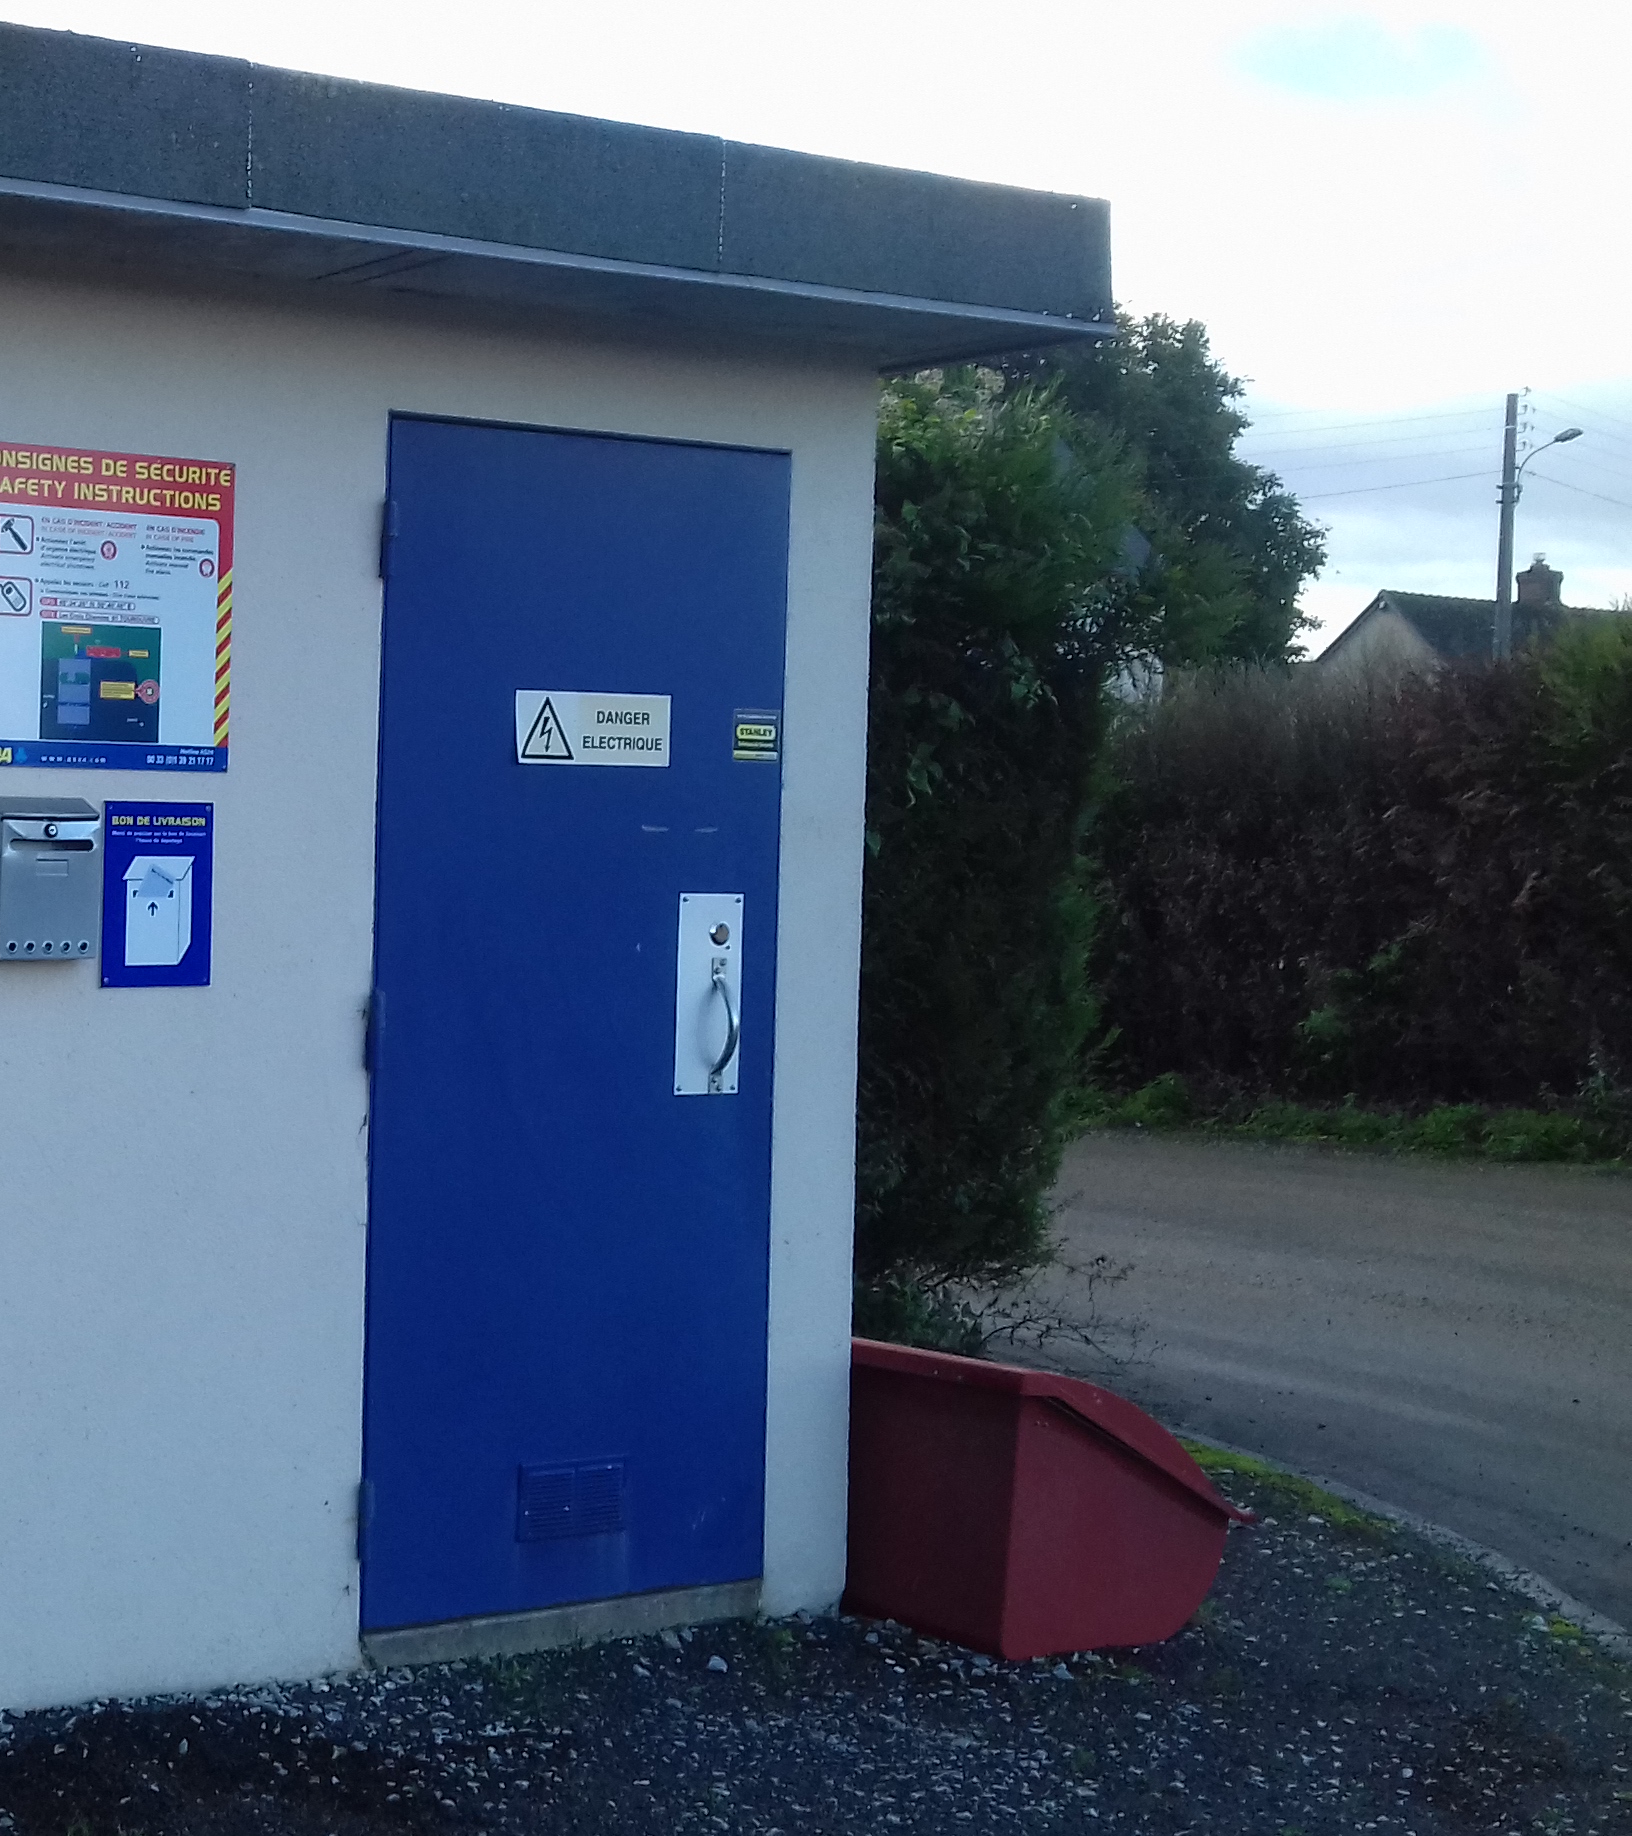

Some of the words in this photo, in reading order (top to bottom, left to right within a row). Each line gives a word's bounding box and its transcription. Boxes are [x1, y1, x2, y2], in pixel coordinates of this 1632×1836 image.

[101, 459, 127, 477] DE
[74, 482, 221, 511] INSTRUCTIONS
[114, 580, 130, 589] 112
[596, 711, 650, 725] DANGER
[740, 728, 773, 737] STANLEY
[582, 736, 662, 751] ELECTRIQUE
[112, 816, 134, 825] BON
[137, 816, 150, 825] DE
[153, 816, 206, 826] LIVRAISON
